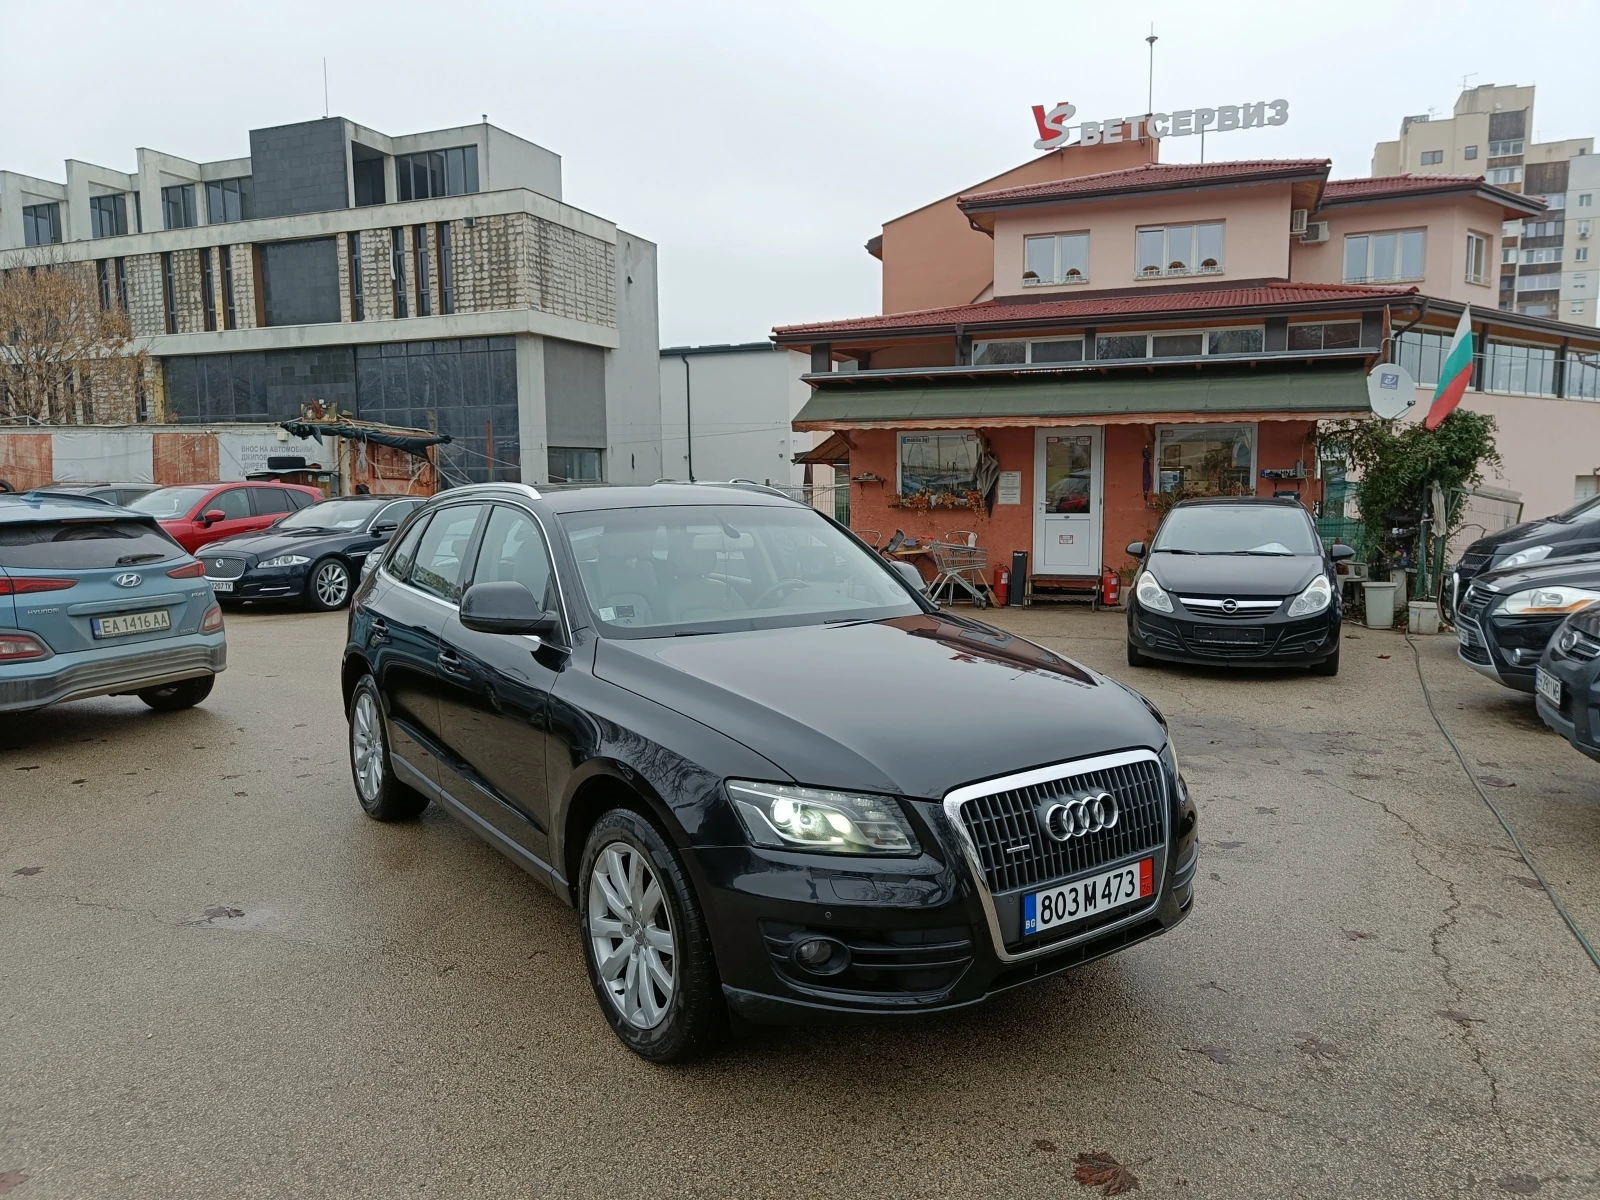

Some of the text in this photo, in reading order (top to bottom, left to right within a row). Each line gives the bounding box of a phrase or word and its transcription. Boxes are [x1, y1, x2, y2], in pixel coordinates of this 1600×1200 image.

[1080, 98, 1289, 147] ВЕТСЕРВИЗ
[241, 445, 258, 453] ВНОС
[259, 445, 268, 453] НА
[27, 607, 59, 615] HYUNDAI
[102, 619, 120, 634] EA
[123, 615, 151, 631] 1416
[153, 612, 168, 627] AA
[1040, 869, 1136, 925] 803 M 473
[1025, 919, 1036, 930] BG
